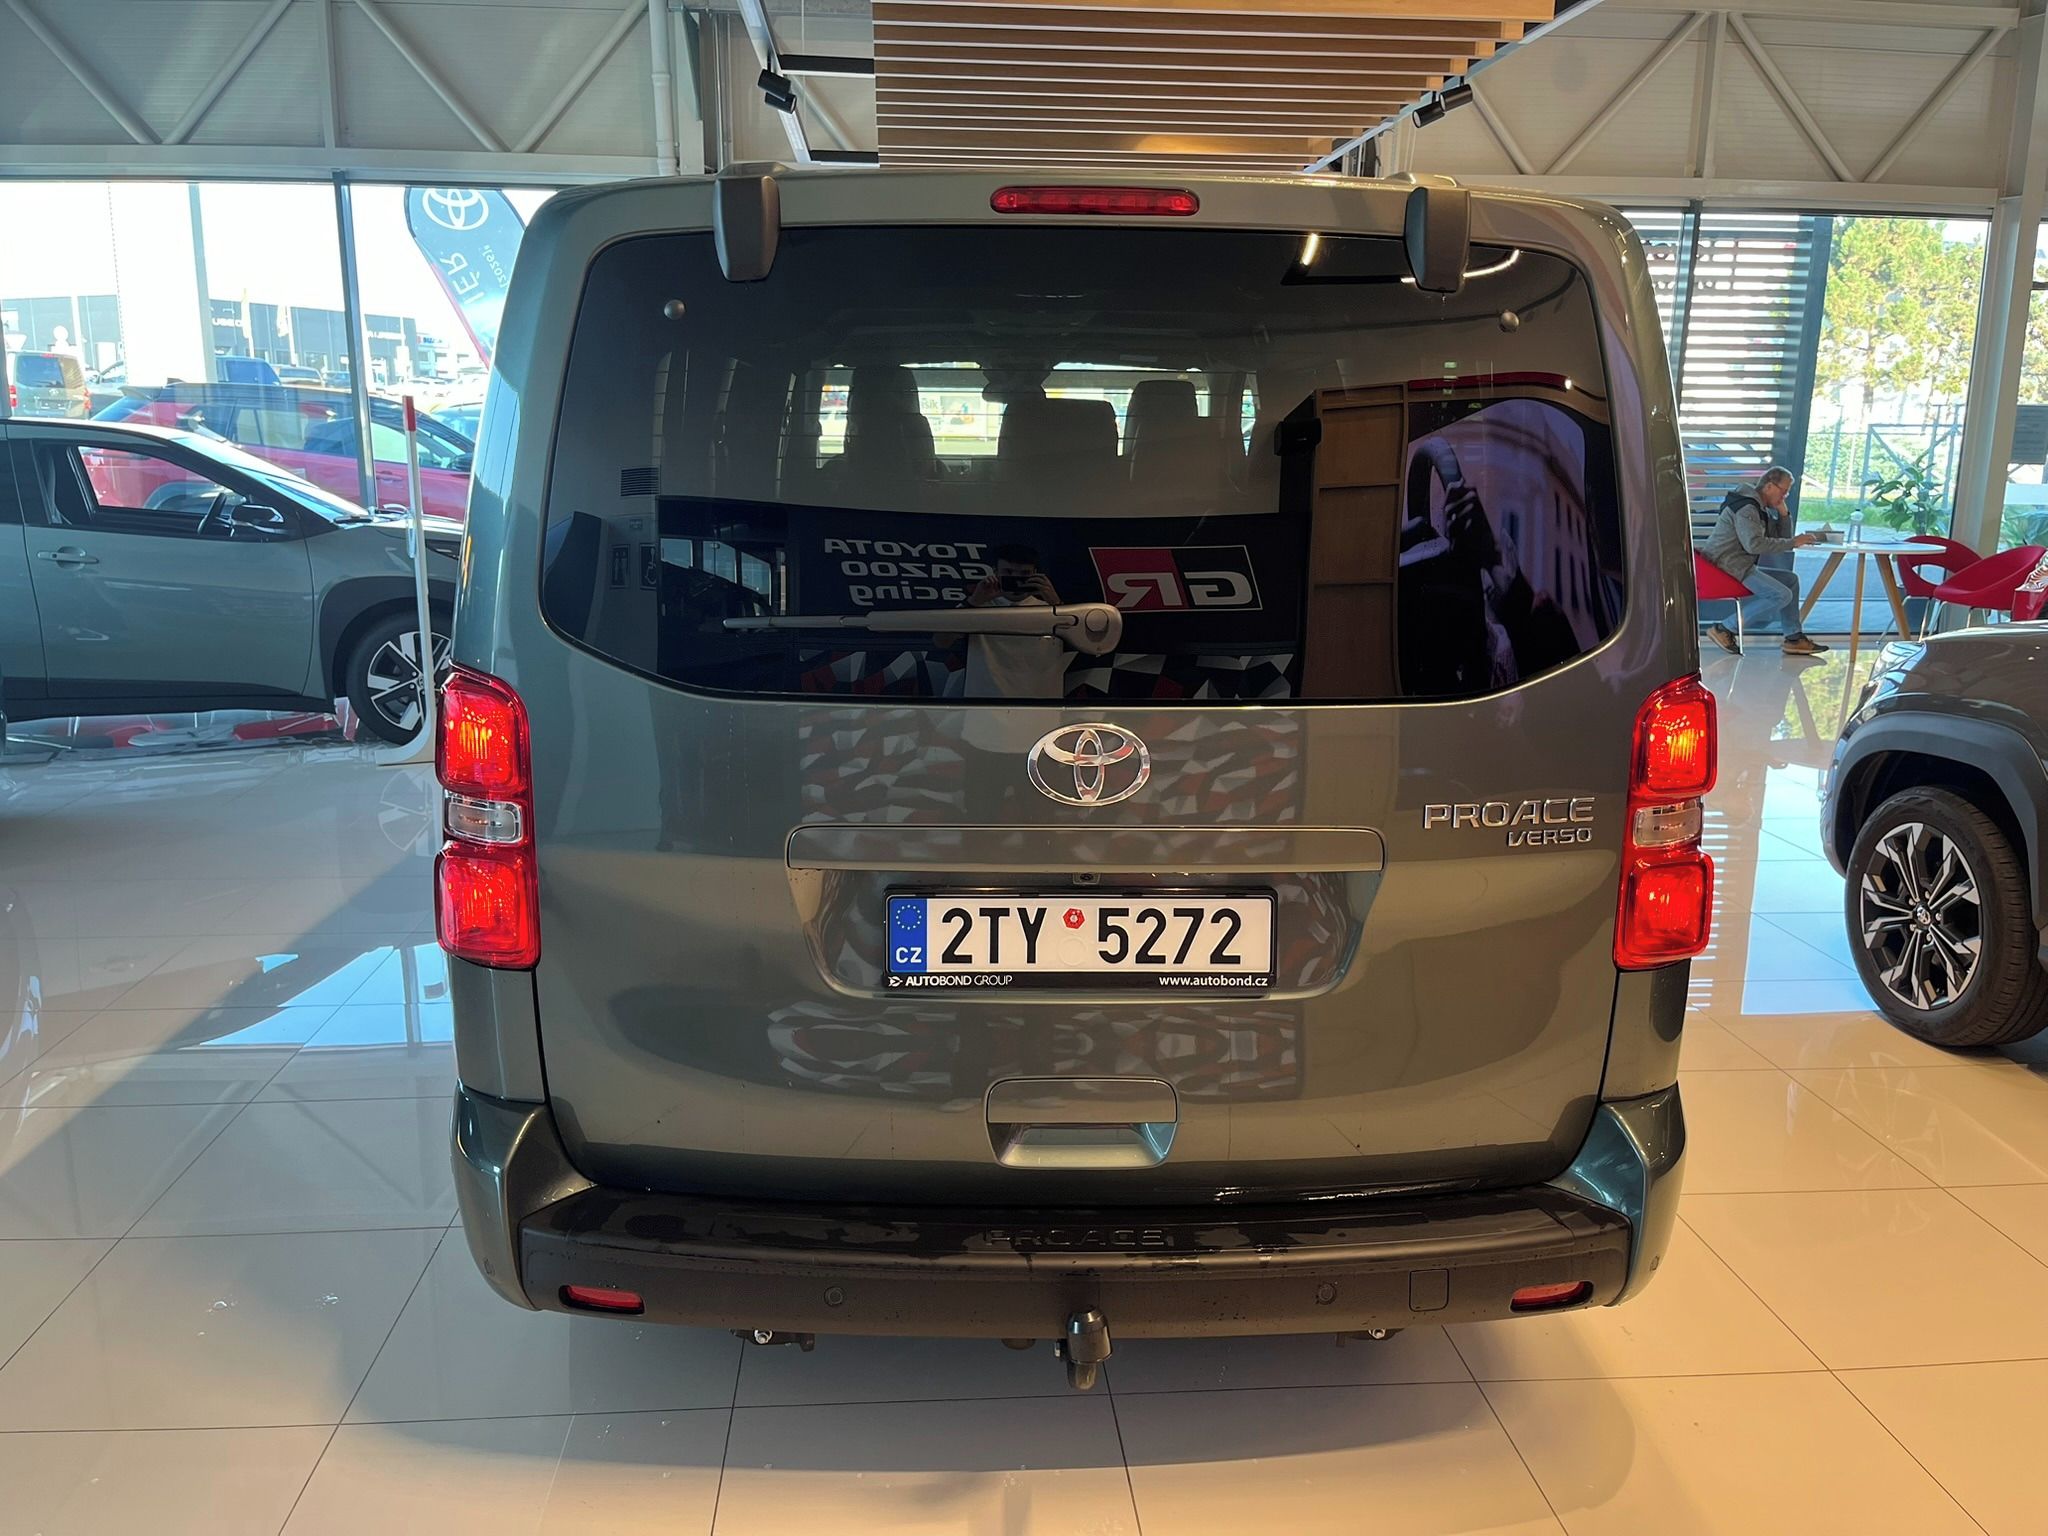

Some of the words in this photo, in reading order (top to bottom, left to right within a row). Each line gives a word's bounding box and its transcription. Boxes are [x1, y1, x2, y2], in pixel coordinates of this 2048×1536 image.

[1424, 797, 1595, 829] PROACE
[1508, 828, 1592, 847] VERSO
[941, 907, 1048, 965] 2TY
[1098, 908, 1242, 965] 5272
[895, 947, 922, 963] CZ
[905, 975, 971, 987] AUTOBOND
[974, 975, 1013, 986] GROUP
[1159, 975, 1268, 987] www.autobond.cz
[985, 1229, 1164, 1247] PROACE
